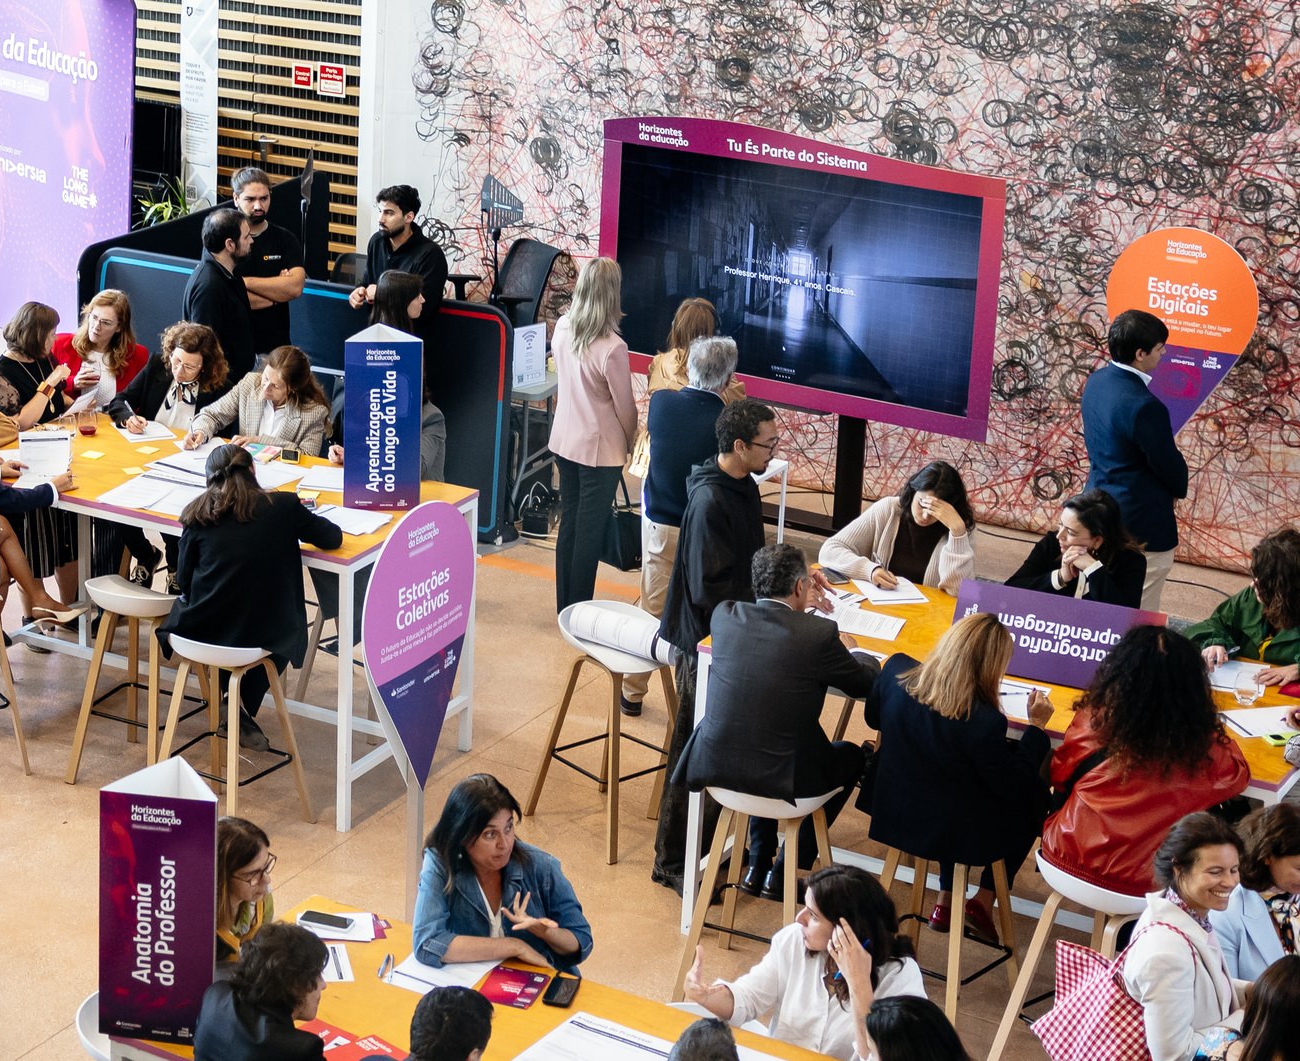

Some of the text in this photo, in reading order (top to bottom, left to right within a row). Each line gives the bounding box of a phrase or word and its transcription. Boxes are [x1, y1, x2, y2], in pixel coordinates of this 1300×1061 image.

[2, 33, 25, 62] da
[27, 37, 98, 84] Educação
[638, 122, 683, 137] Horizontes
[639, 131, 689, 148] da educação
[726, 138, 868, 172] Tu És Parte do Sistema
[71, 165, 88, 182] THE
[63, 175, 88, 195] LONG
[62, 190, 88, 209] GAME
[1167, 240, 1202, 251] Horizontes
[1176, 247, 1207, 259] Educação
[724, 265, 758, 279] Professor
[758, 271, 792, 286] Henrique,
[804, 281, 824, 291] anos.
[825, 284, 856, 297] Cascais.
[1147, 276, 1218, 300] Estações
[1148, 293, 1209, 316] Digitais
[1181, 325, 1196, 335] papel
[1207, 322, 1216, 330] teu
[1217, 323, 1232, 333] lugar
[374, 354, 400, 362] Educação
[381, 370, 397, 403] Vida
[381, 406, 396, 425] da
[365, 388, 384, 492] Aprendizagem
[381, 427, 399, 471] Longo
[384, 473, 395, 492] ao
[407, 521, 436, 540] Horizontes
[408, 527, 439, 549] da Educação
[398, 567, 450, 608] Estações
[396, 589, 449, 630] Coletivas
[381, 648, 386, 656] O
[386, 641, 400, 653] futuro
[406, 628, 425, 643] Educação
[1019, 634, 1107, 662] artografia
[131, 804, 175, 817] Horizontes
[131, 813, 182, 826] da Educação
[154, 855, 176, 986] do Professor
[131, 883, 152, 985] Anatomia
